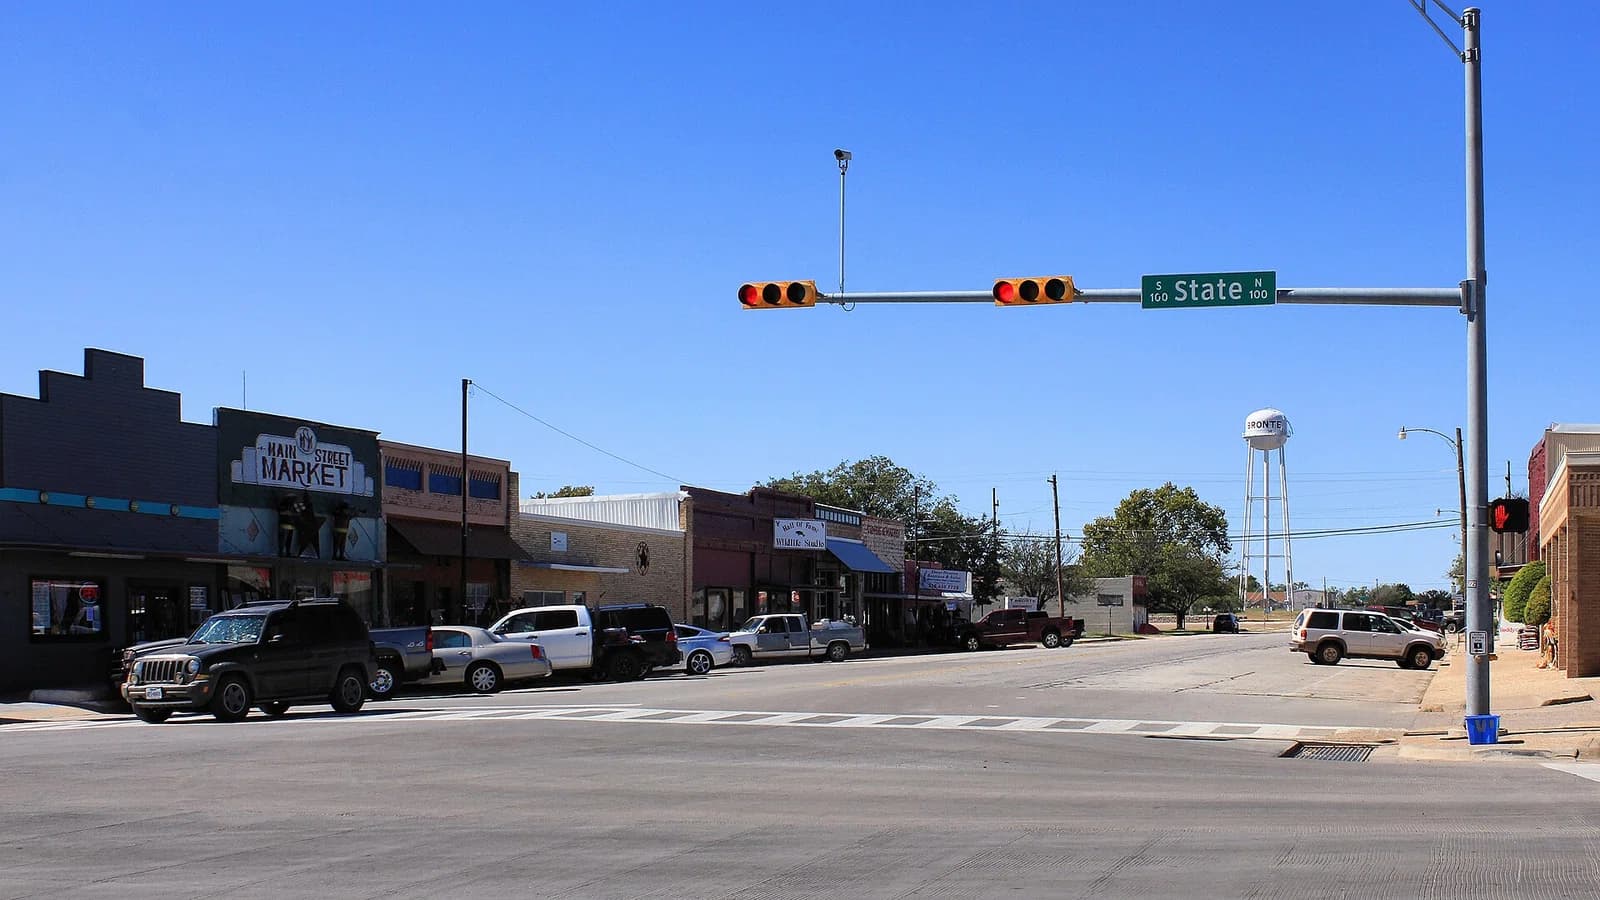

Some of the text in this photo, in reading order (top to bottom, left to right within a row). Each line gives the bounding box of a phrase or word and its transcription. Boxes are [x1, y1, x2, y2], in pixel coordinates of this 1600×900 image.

[1155, 281, 1162, 291] S
[1255, 278, 1262, 287] N
[1174, 278, 1243, 302] State
[1249, 290, 1268, 299] 100
[1150, 292, 1168, 302] 100
[267, 442, 350, 466] MAIN STREET
[261, 455, 349, 488] MARKET
[782, 522, 795, 532] Hall
[804, 539, 825, 548] Studio
